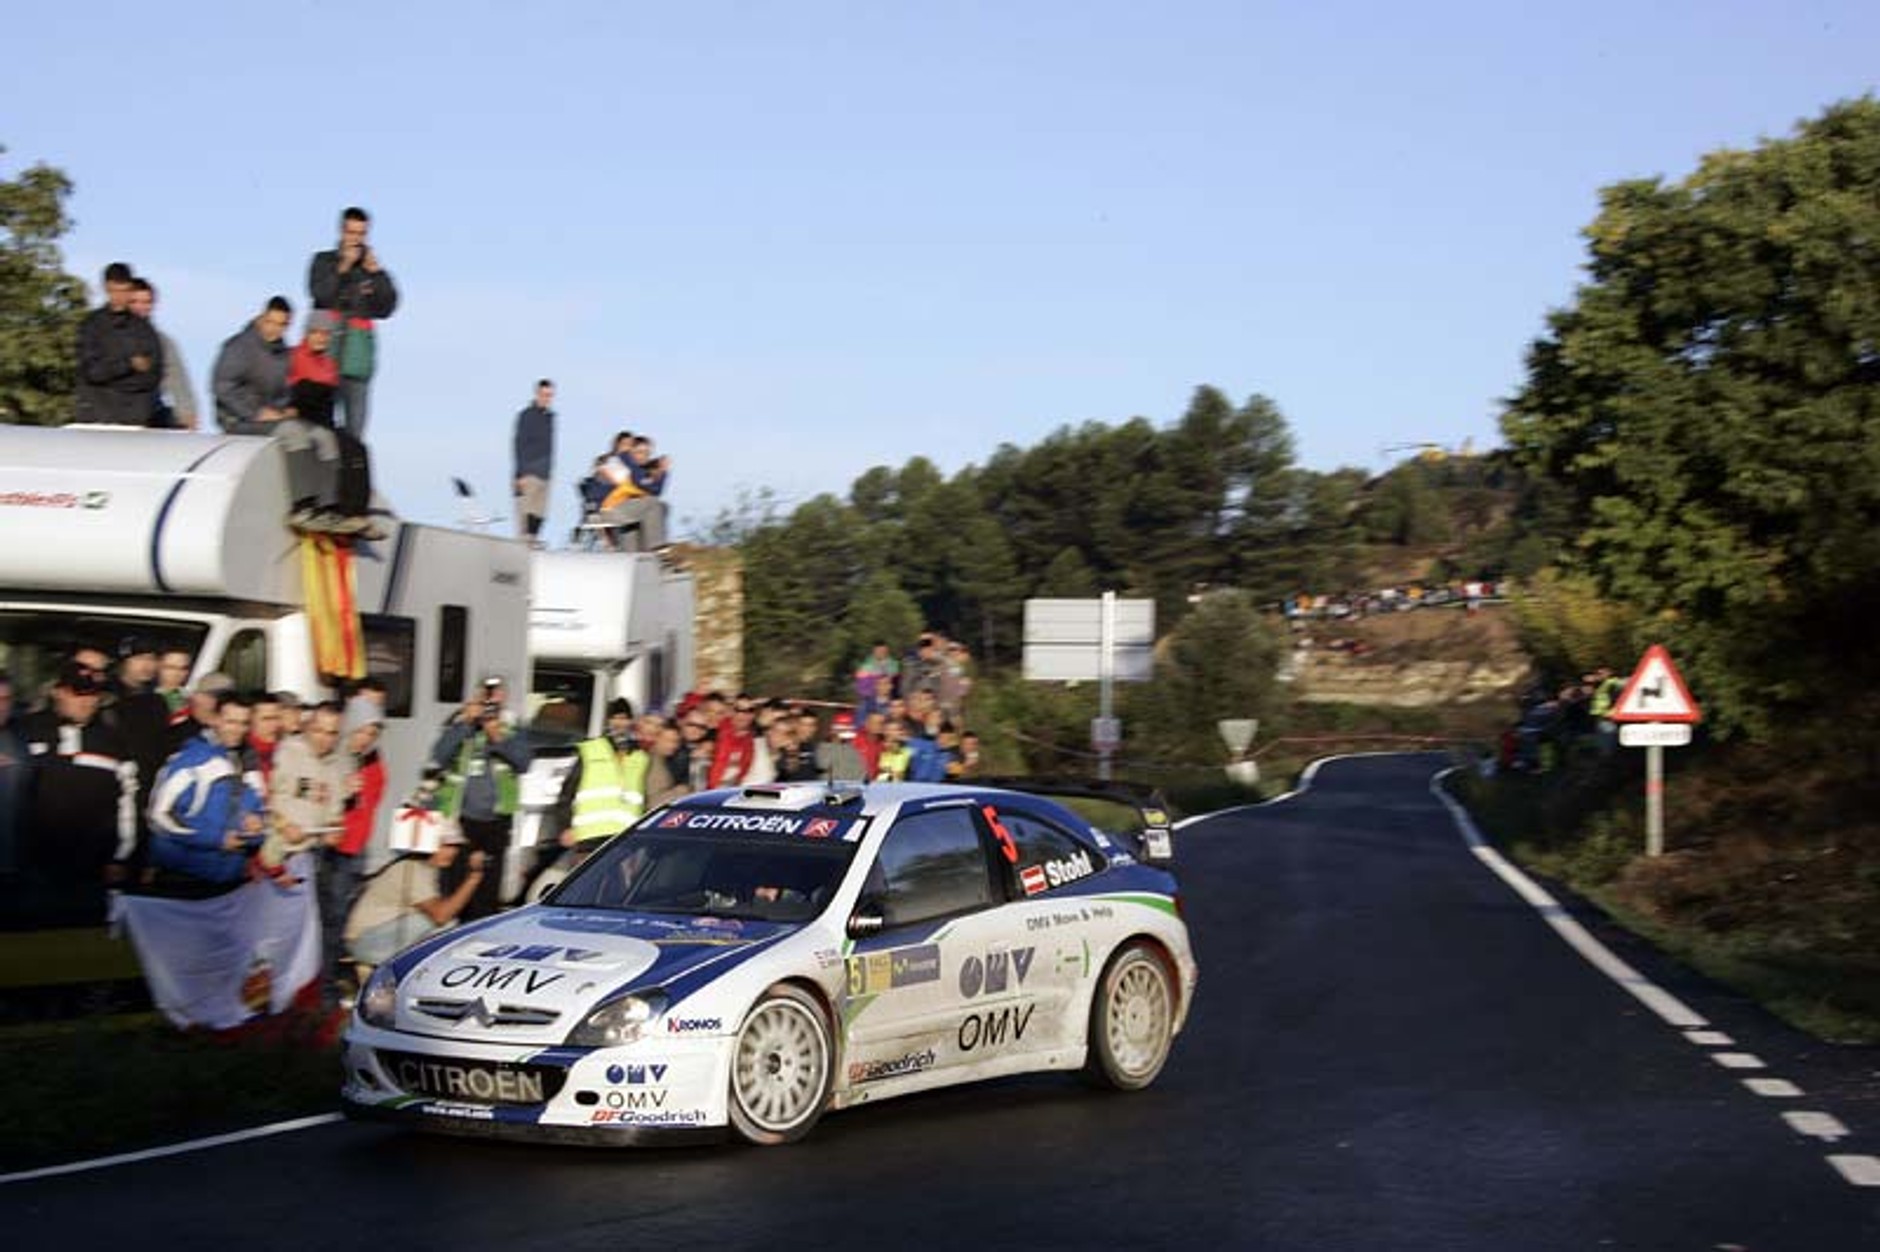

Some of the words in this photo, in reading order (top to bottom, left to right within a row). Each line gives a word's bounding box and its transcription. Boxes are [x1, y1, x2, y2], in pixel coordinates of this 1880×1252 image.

[687, 815, 802, 834] CITROËN
[982, 805, 1019, 864] 5
[1045, 849, 1094, 886] Stohl
[441, 965, 565, 994] OMV
[850, 957, 862, 994] 5
[958, 1003, 1036, 1051] OMV
[400, 1059, 545, 1101] CITROËN
[606, 1090, 668, 1109] OMV
